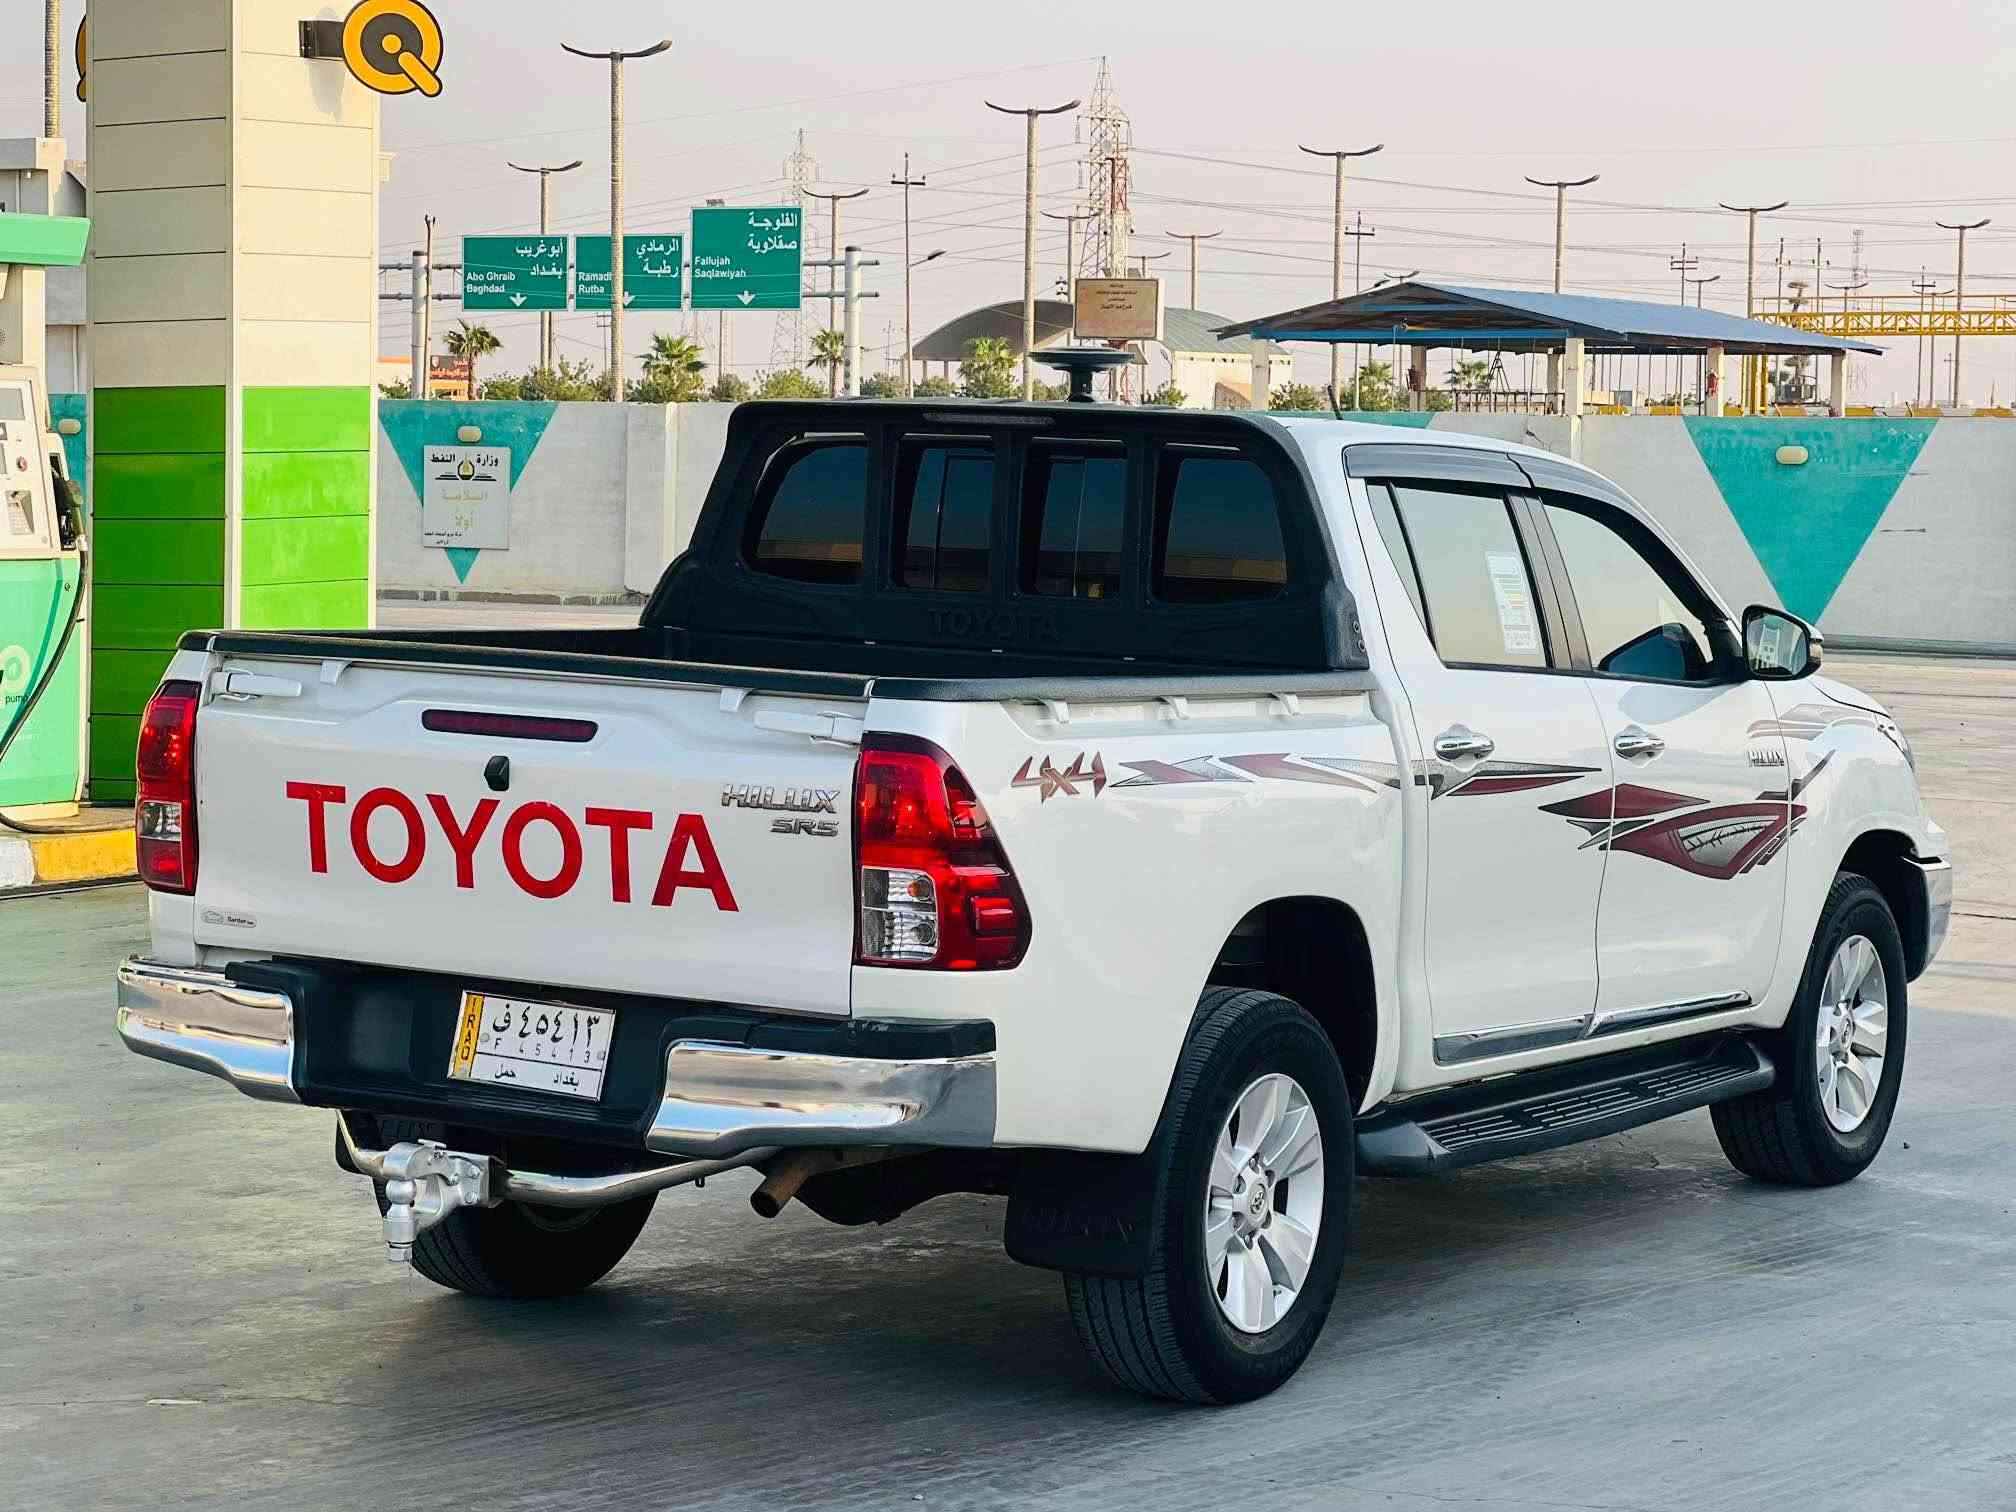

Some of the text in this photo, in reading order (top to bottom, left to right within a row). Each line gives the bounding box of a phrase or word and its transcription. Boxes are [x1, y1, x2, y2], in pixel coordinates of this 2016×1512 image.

[748, 211, 799, 231] الفلوجة
[635, 237, 680, 259] الرمادي
[747, 233, 798, 254] صقلاوية
[642, 258, 680, 278] رطبة
[694, 256, 731, 268] Fallujah
[466, 271, 516, 282] Abo Ghraib
[530, 263, 563, 280] بغداد
[694, 269, 747, 281] Saqlawiyah
[466, 283, 505, 296] Baghdad
[578, 283, 606, 295] Rutba
[431, 453, 499, 467] وزارة النفط
[721, 783, 840, 814] HILUX
[286, 779, 739, 913] TOYOTA
[494, 1063, 580, 1092] بغداد حمل
